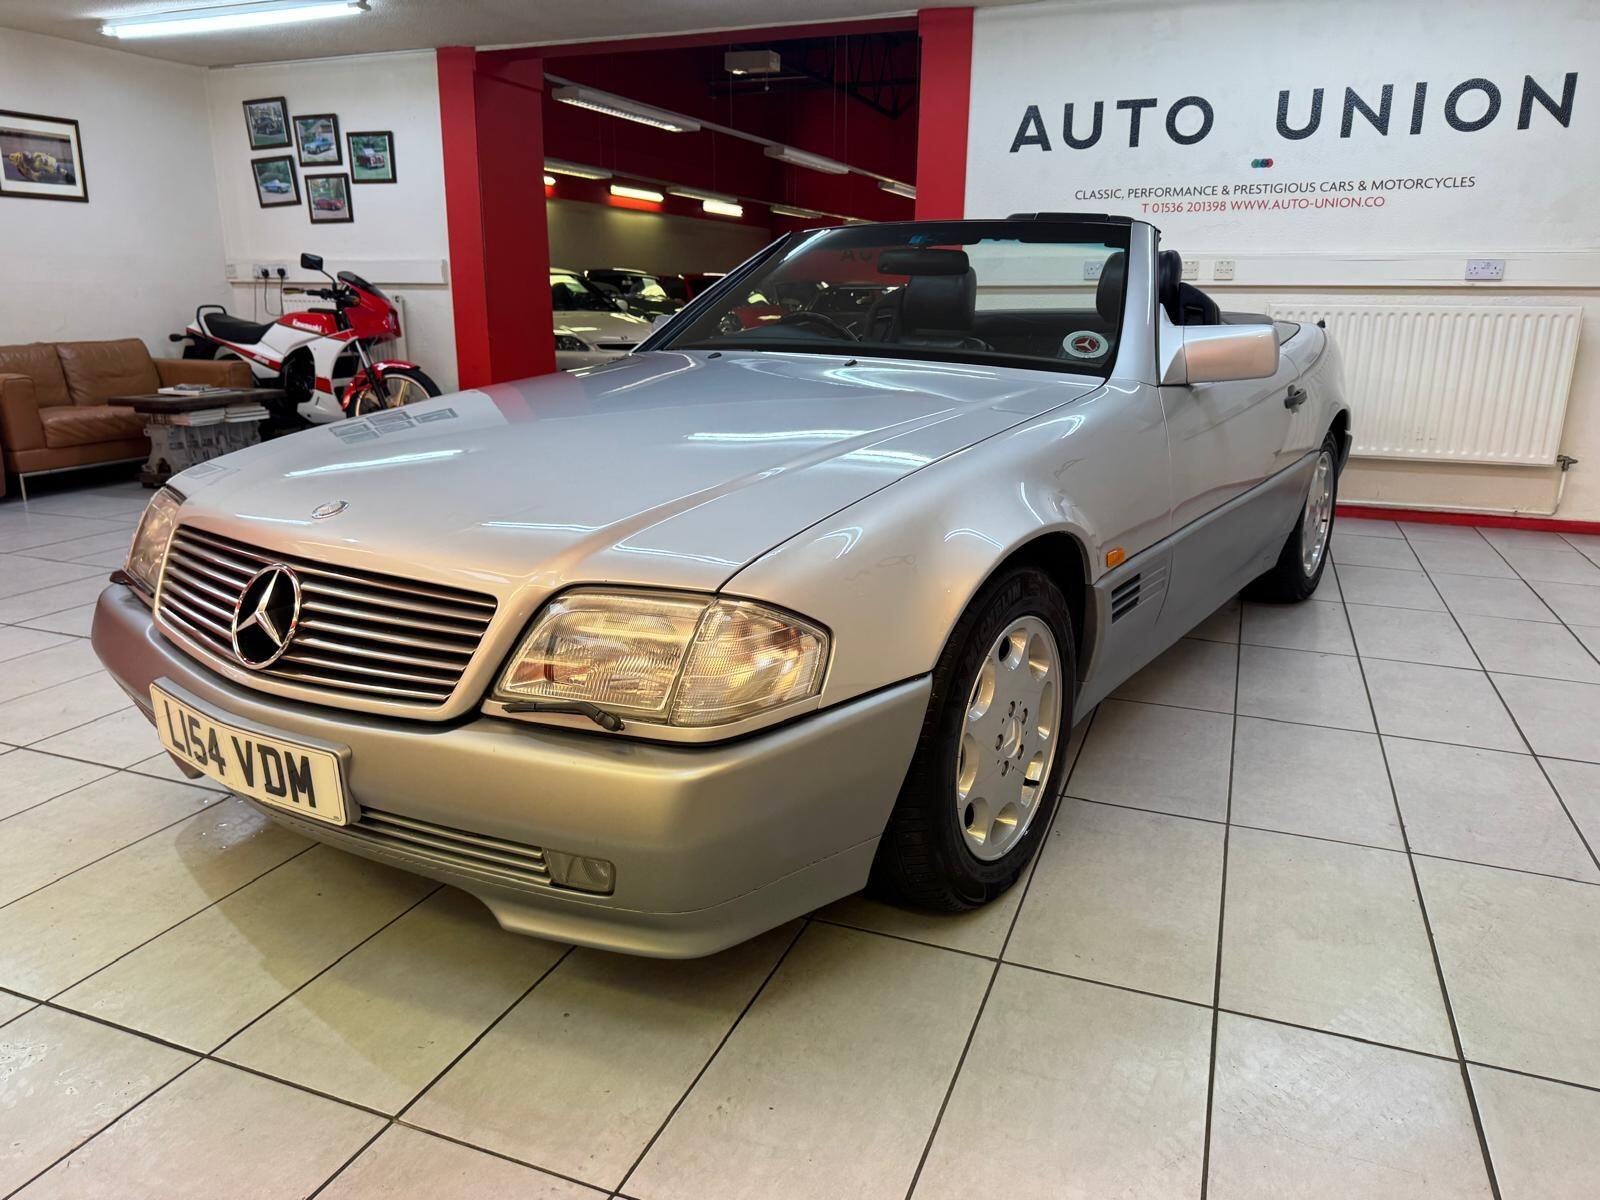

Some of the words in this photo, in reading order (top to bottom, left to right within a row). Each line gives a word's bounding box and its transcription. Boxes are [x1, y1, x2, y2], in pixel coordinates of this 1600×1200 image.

[1010, 96, 1214, 153] AUTO
[1276, 73, 1579, 141] UNION
[1075, 188, 1125, 201] CLASSIC,
[1128, 186, 1219, 199] PERFORMANCE
[1221, 185, 1231, 196] &
[1234, 182, 1316, 196] PRESTIGIOUS
[1320, 181, 1355, 193] CARS
[1358, 180, 1368, 191] &
[1371, 176, 1476, 191] MOTORCYCLES
[1142, 203, 1150, 214] T
[1152, 202, 1184, 214] 01536
[1187, 201, 1227, 213] 201398
[1230, 197, 1386, 211] WWW.AUTO-UNION.CO
[165, 701, 226, 776] L154
[231, 736, 316, 809] VDM
